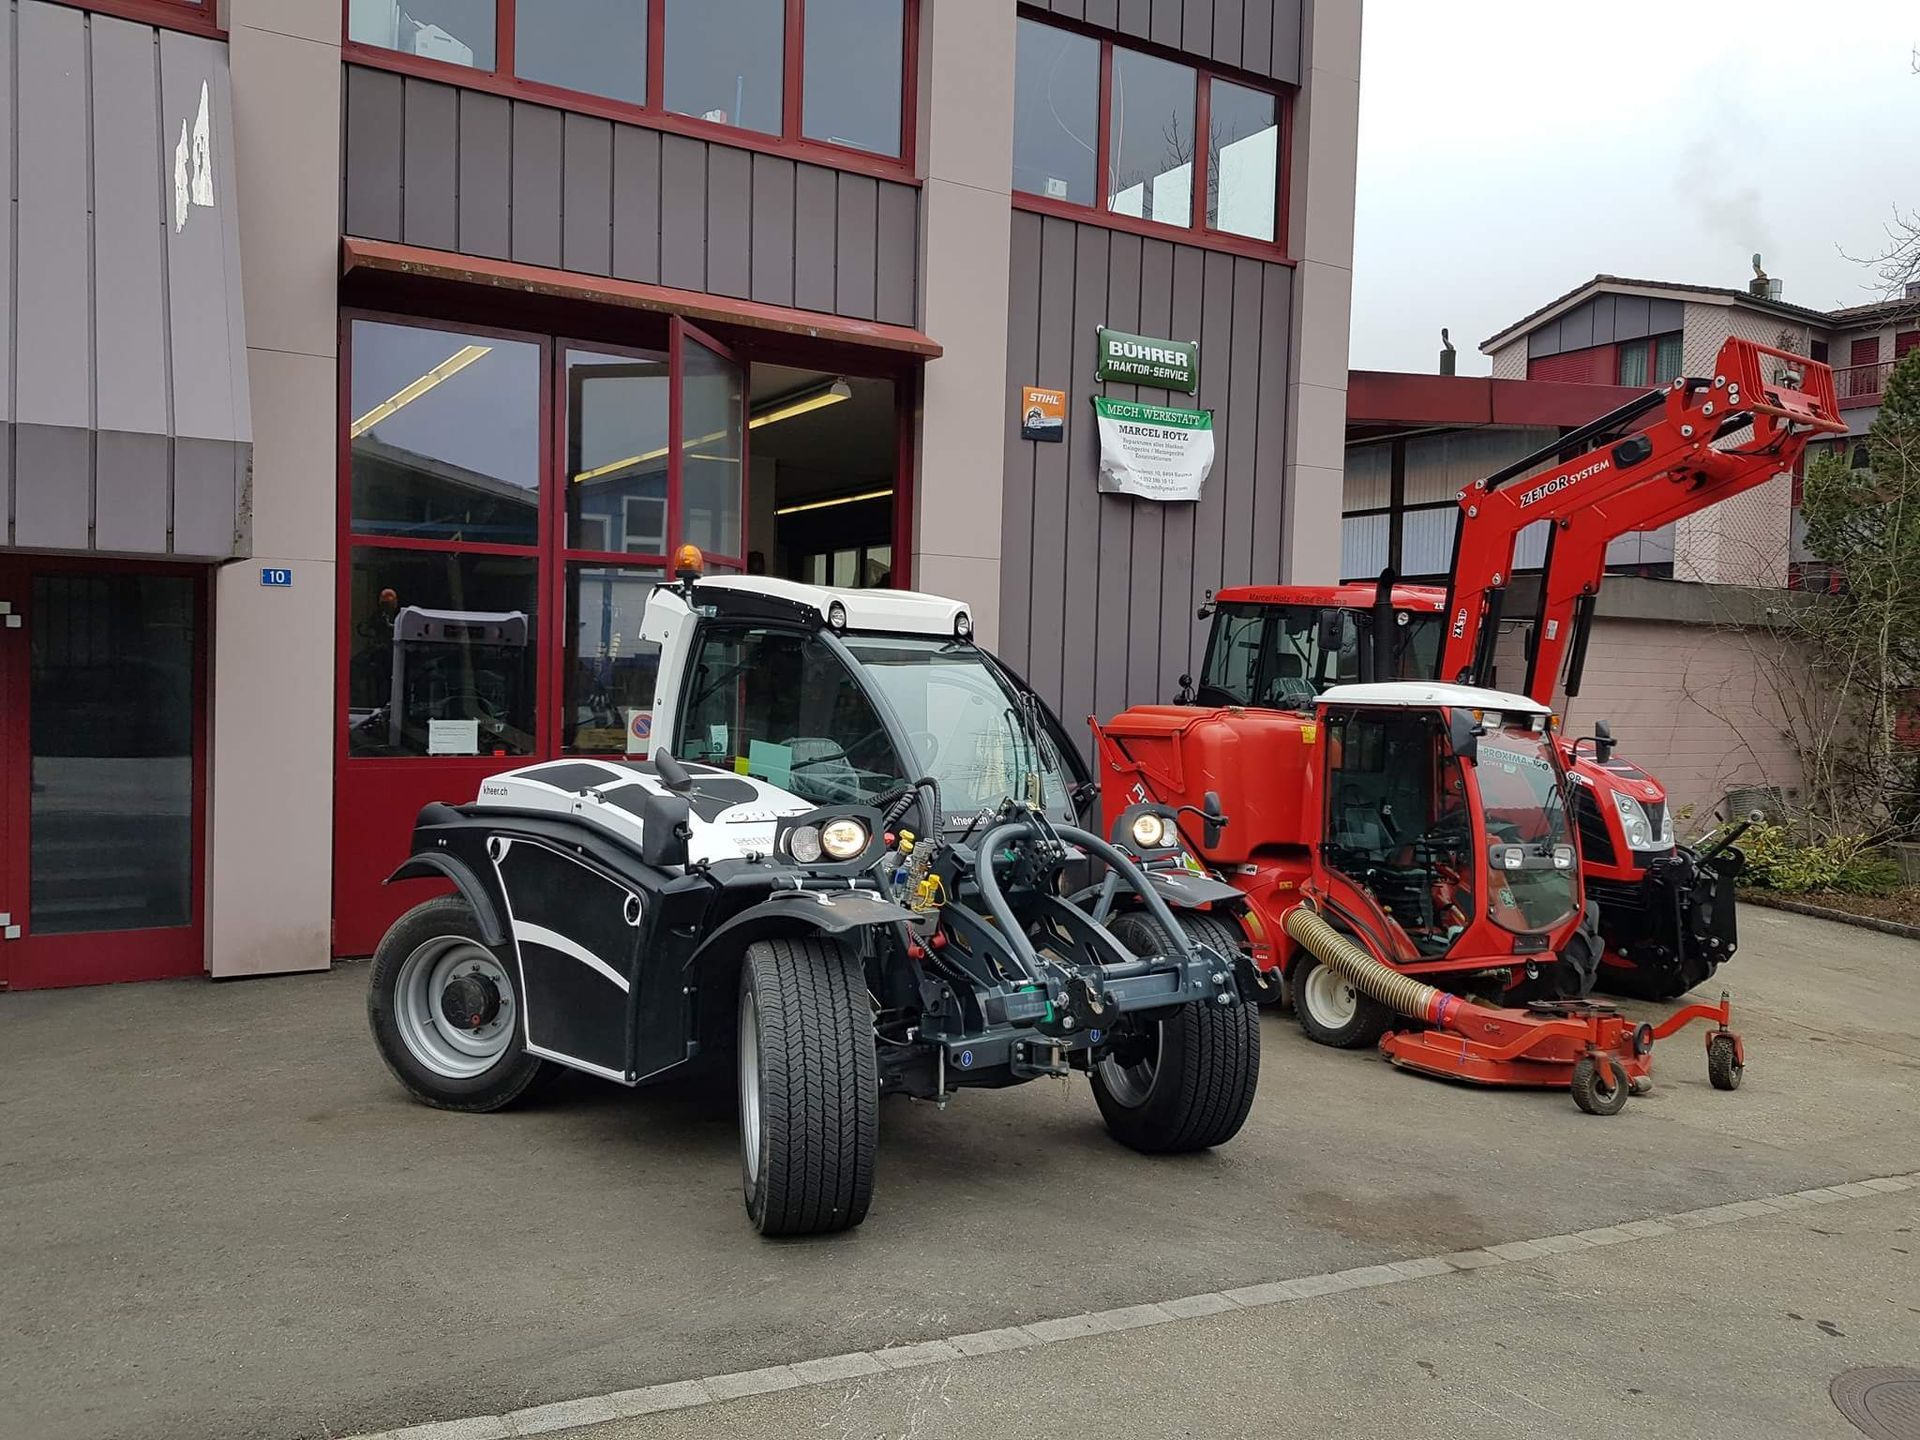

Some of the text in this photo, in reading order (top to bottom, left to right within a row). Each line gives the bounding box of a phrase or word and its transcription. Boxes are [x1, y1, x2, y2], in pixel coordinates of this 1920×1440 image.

[1107, 360, 1189, 382] TRAKTOR-SERVICE
[1029, 393, 1059, 405] STIHL
[1107, 404, 1201, 425] MECH. WERKSTATT
[1119, 425, 1189, 441] MARCEL HOTZ
[1520, 459, 1610, 509] ZETOR SYSTEM
[270, 570, 285, 583] 10
